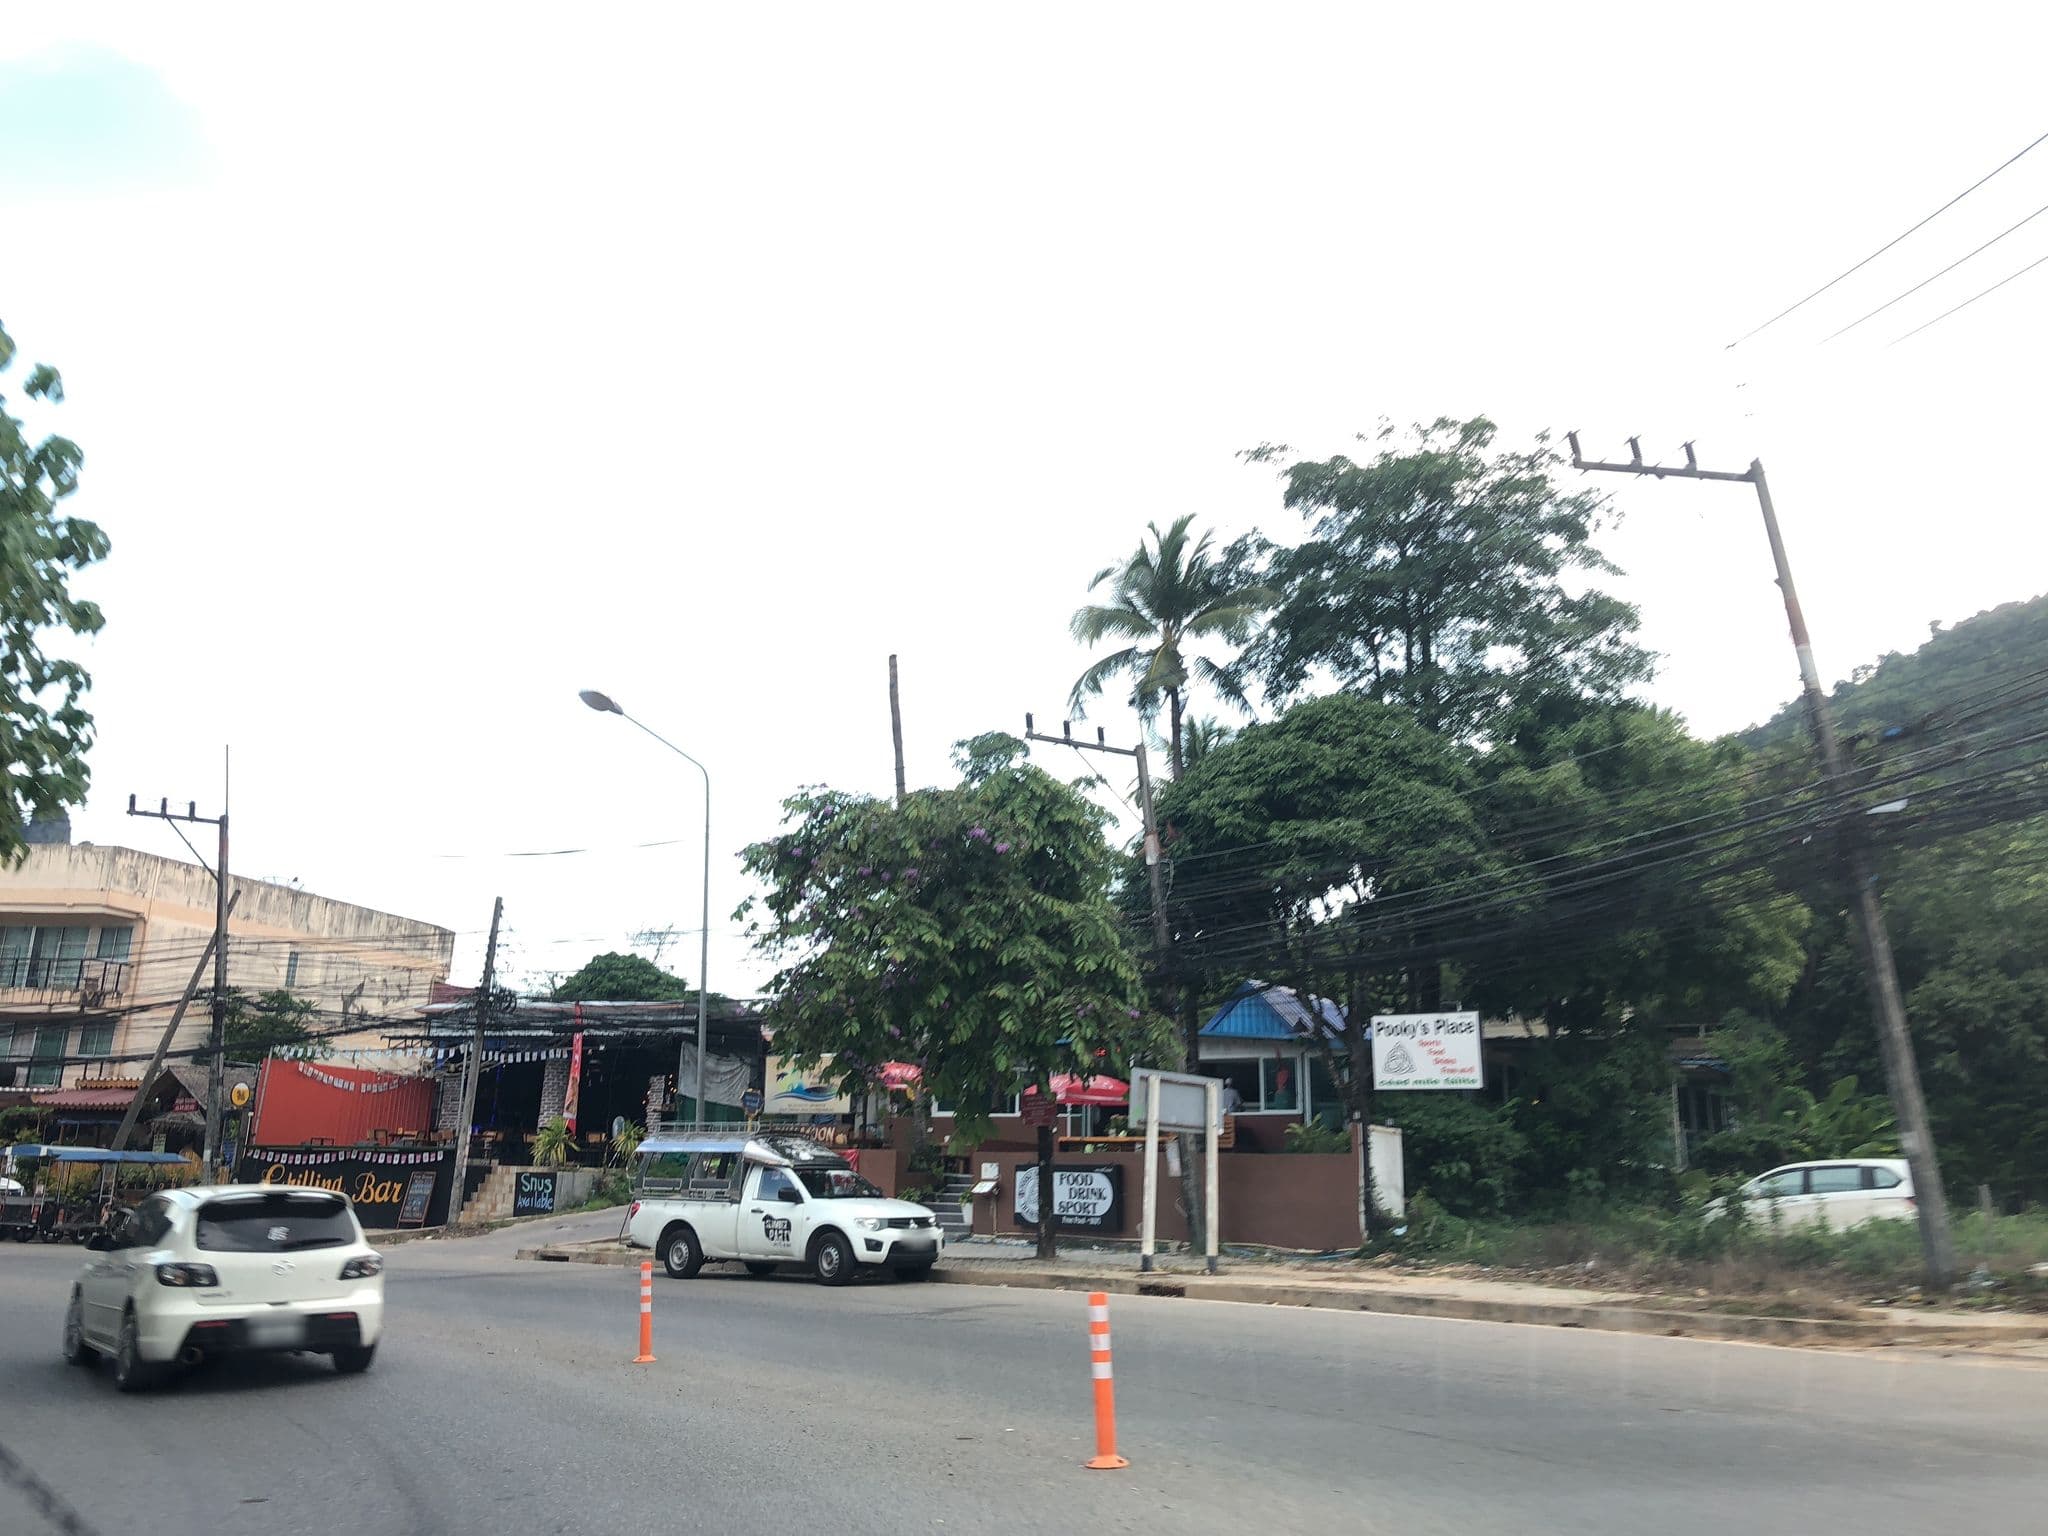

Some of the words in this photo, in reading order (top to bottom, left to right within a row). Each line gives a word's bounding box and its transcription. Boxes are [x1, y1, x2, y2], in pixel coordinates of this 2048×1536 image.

[1434, 1018, 1475, 1036] Place
[352, 1171, 403, 1204] Bar
[520, 1172, 553, 1193] Snus
[1059, 1173, 1094, 1186] FOOD
[1068, 1187, 1107, 1200] DRINK
[1058, 1200, 1099, 1214] SPORT
